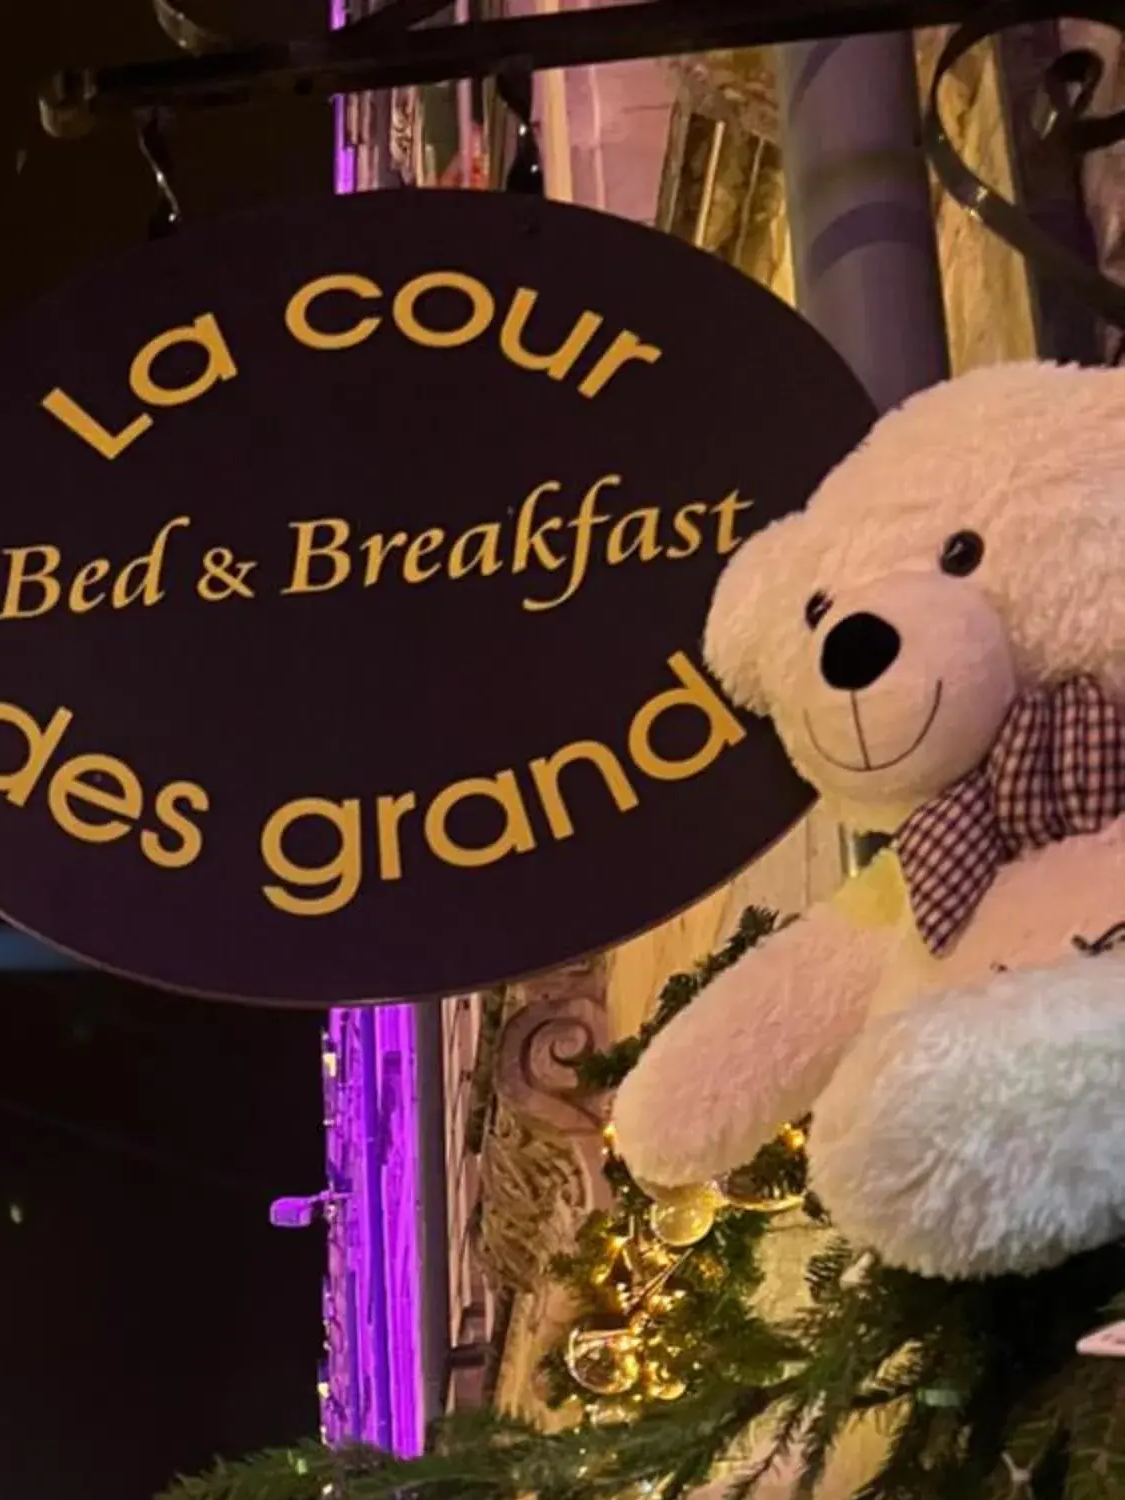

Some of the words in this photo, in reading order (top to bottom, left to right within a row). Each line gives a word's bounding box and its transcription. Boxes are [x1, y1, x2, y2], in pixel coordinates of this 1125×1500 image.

[41, 312, 238, 459] La
[284, 271, 663, 398] cour
[197, 547, 256, 600] &
[280, 474, 754, 611] Breakfast
